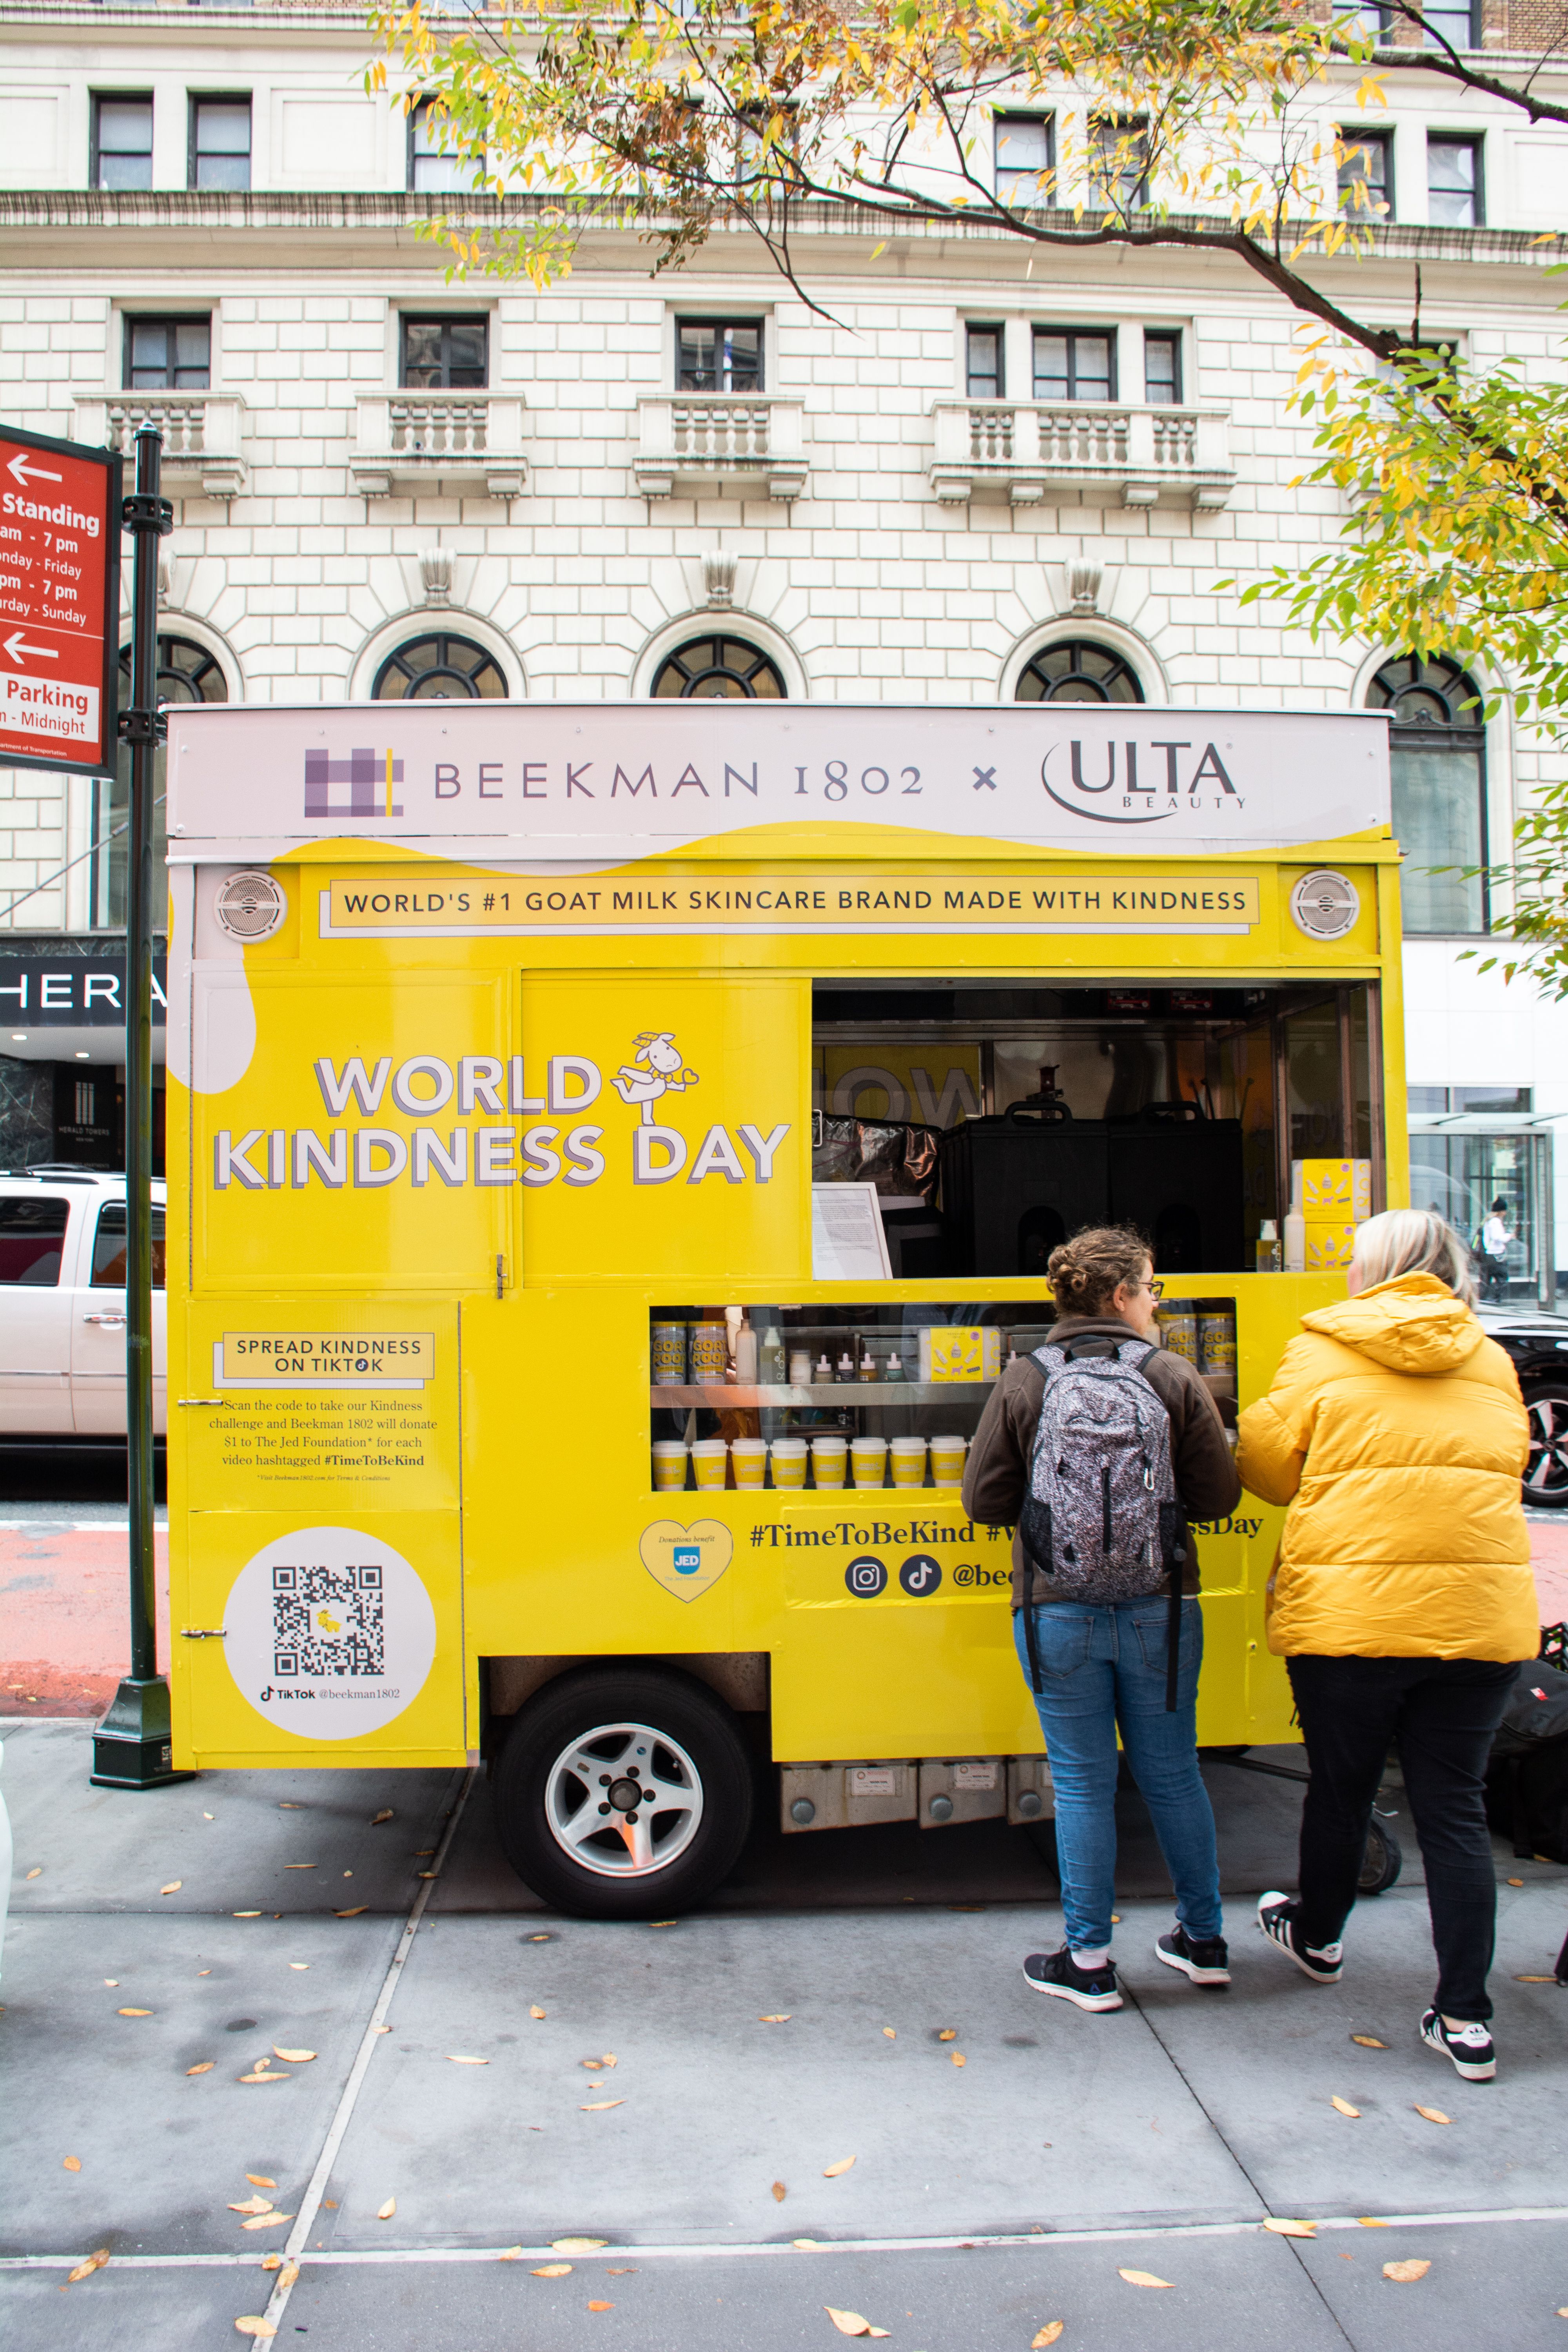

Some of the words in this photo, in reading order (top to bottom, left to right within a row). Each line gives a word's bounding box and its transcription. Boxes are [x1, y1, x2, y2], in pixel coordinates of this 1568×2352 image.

[2, 493, 100, 537] Standing
[44, 532, 52, 547] 7
[56, 538, 78, 554] pm
[0, 551, 33, 571] nday
[44, 558, 82, 581] Friday
[43, 579, 51, 595] 7
[55, 585, 77, 601] pm
[0, 598, 31, 617] rday
[42, 604, 86, 627] Sunday
[7, 679, 88, 716] Parking
[21, 711, 85, 735] Midnight
[29, 746, 67, 757] Transportation
[435, 762, 758, 799] BEEKMAN
[794, 760, 923, 801] 1802
[1070, 740, 1236, 795] ULTA
[1123, 797, 1246, 808] BEAUTY
[344, 893, 471, 913] WORLD'S
[483, 893, 511, 912] #1
[525, 893, 601, 911] GOAT
[613, 892, 678, 910] MILK
[689, 891, 826, 910] SKINCARE
[839, 891, 932, 909] BRAND
[945, 891, 1022, 909] MADE
[1033, 891, 1100, 909] WITH
[1113, 891, 1246, 910] KINDNESS
[314, 1054, 603, 1117] WORLD
[214, 1124, 606, 1190] KINDNESS
[632, 1123, 792, 1185] DAY
[237, 1340, 313, 1354] SPREAD
[321, 1341, 421, 1354] KINDNESS
[275, 1358, 304, 1372] ON
[224, 1400, 251, 1411] Scan
[255, 1400, 272, 1411] the
[276, 1400, 302, 1411] code
[306, 1401, 316, 1411] to
[320, 1400, 344, 1411] take
[370, 1400, 423, 1411] Kindness
[209, 1418, 263, 1433] challenge
[267, 1418, 287, 1429] and
[291, 1418, 343, 1429] Beekman
[348, 1418, 373, 1429] 1802
[376, 1418, 397, 1429] will
[399, 1418, 437, 1429] donate
[224, 1436, 237, 1448] $1
[240, 1437, 252, 1447] to
[255, 1436, 276, 1447] The
[280, 1436, 299, 1448] Jed
[377, 1436, 393, 1447] for
[396, 1436, 422, 1448] each
[222, 1455, 252, 1466] video
[256, 1454, 321, 1468] hashtagged
[324, 1455, 425, 1466] #TimeToBeKind
[750, 1521, 975, 1548] #TimeToBeKind
[675, 1555, 699, 1566] JED
[953, 1563, 1013, 1588] @be
[277, 1689, 316, 1699] TikTok
[319, 1689, 400, 1699] @beekman1802
